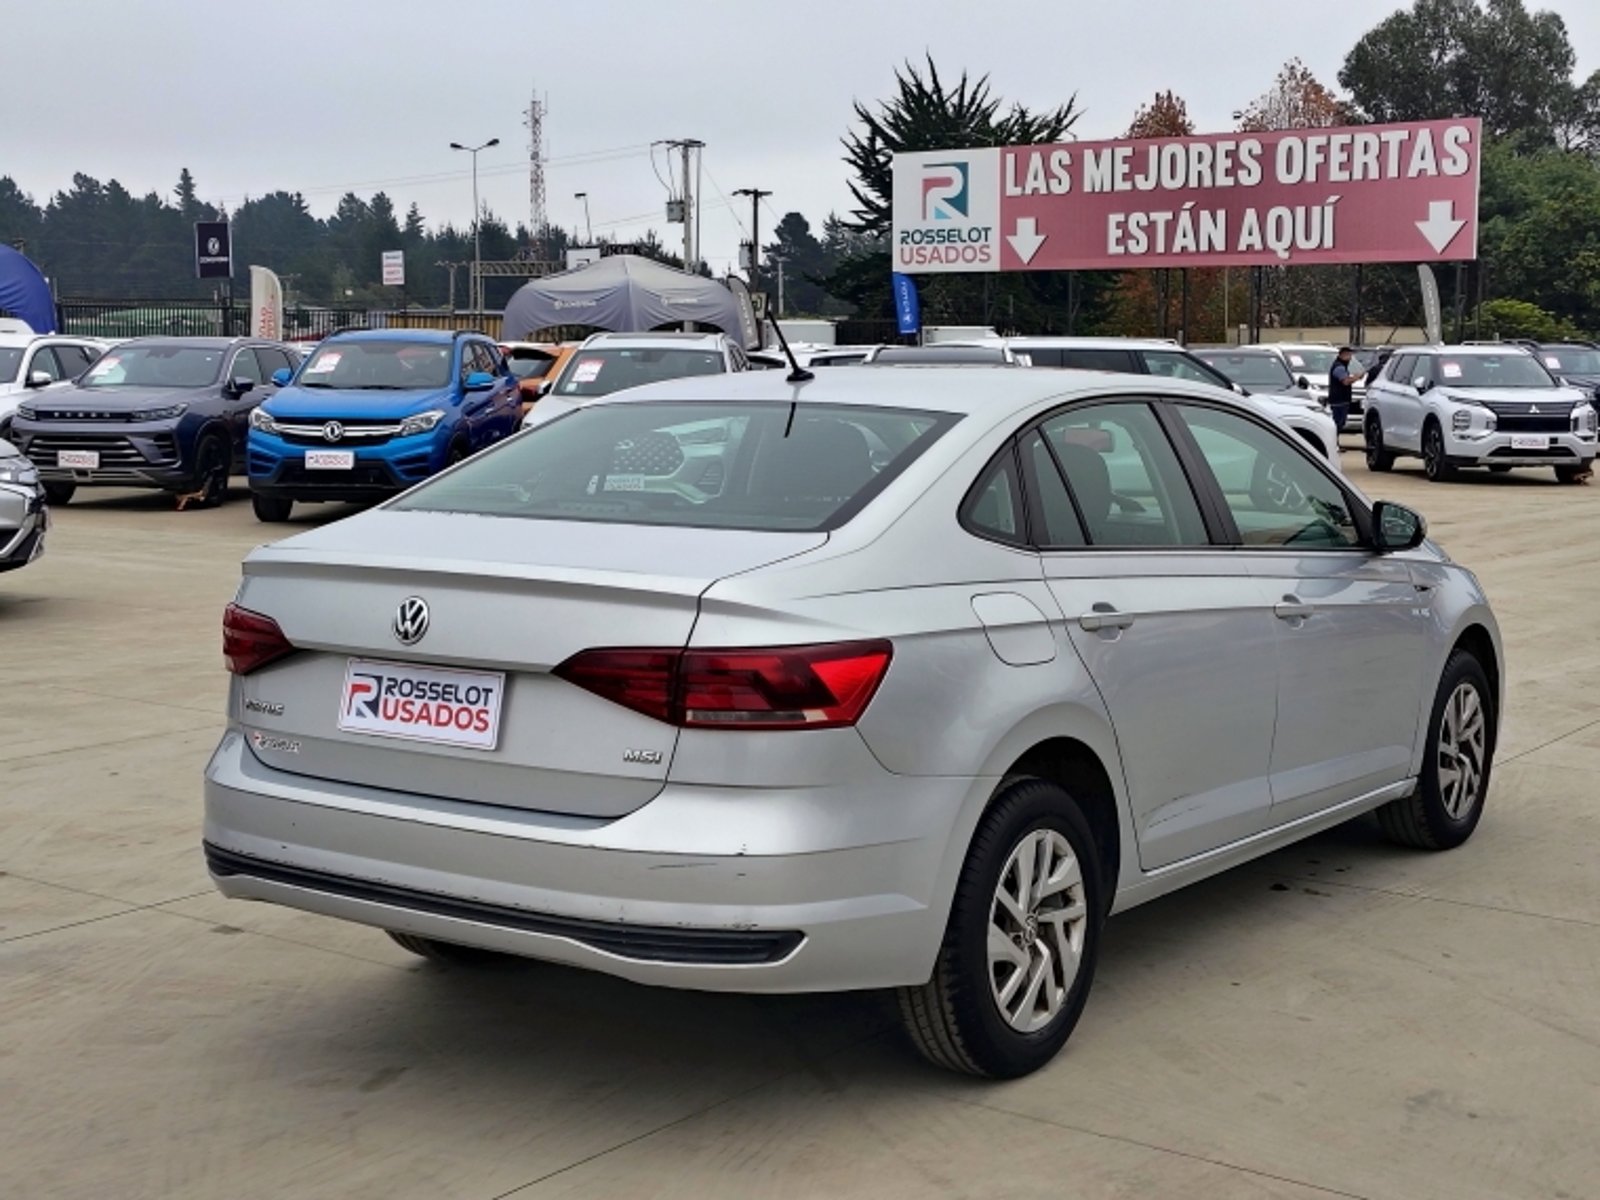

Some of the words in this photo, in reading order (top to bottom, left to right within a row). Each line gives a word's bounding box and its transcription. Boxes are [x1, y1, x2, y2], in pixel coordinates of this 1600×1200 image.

[1005, 150, 1072, 197] LAS
[1083, 139, 1263, 193] MEJORES
[1275, 126, 1471, 184] OFERTAS
[900, 227, 992, 245] ROSSELOT
[1107, 201, 1227, 256] ESTÁN
[1237, 195, 1342, 260] AQUÍ
[900, 245, 991, 265] USADOS
[384, 677, 493, 706] ROSSELOT
[382, 698, 489, 733] USADOS
